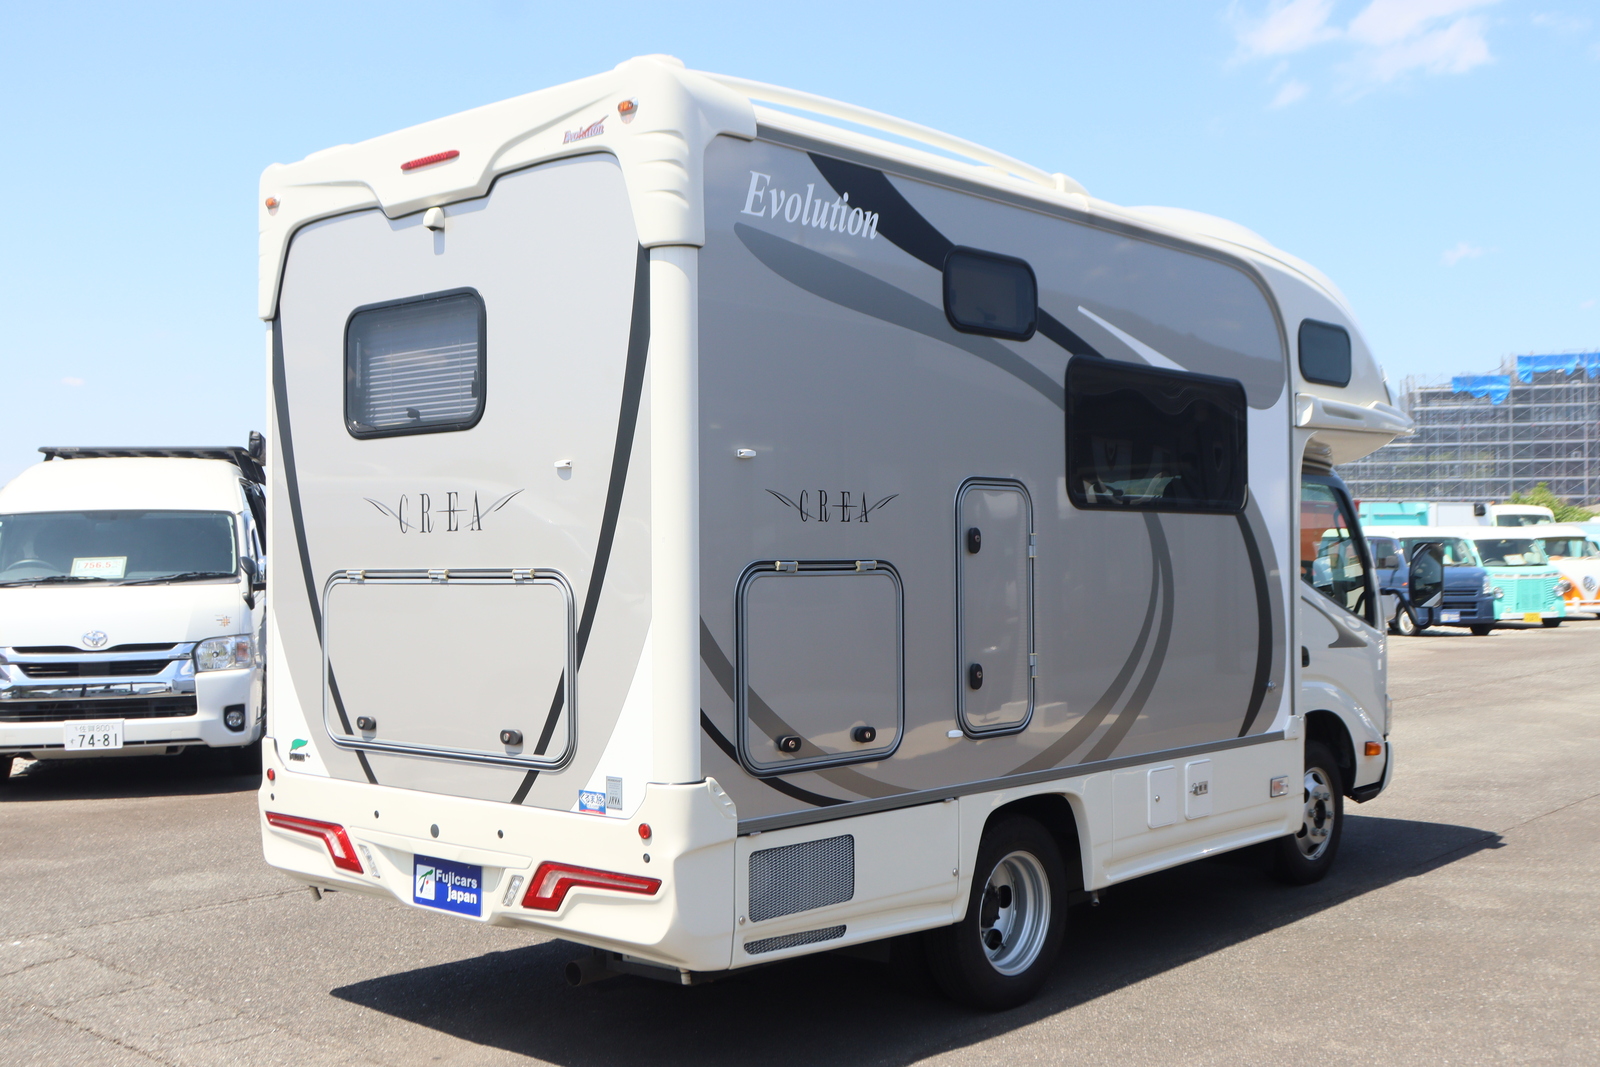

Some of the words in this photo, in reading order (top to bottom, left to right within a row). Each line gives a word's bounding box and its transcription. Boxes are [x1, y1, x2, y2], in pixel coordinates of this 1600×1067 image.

[563, 122, 605, 145] Evolution
[740, 170, 879, 240] Evolution
[398, 490, 483, 534] CREA
[799, 489, 869, 523] CREA
[78, 733, 118, 748] 74-81
[435, 869, 478, 889] Fujicars
